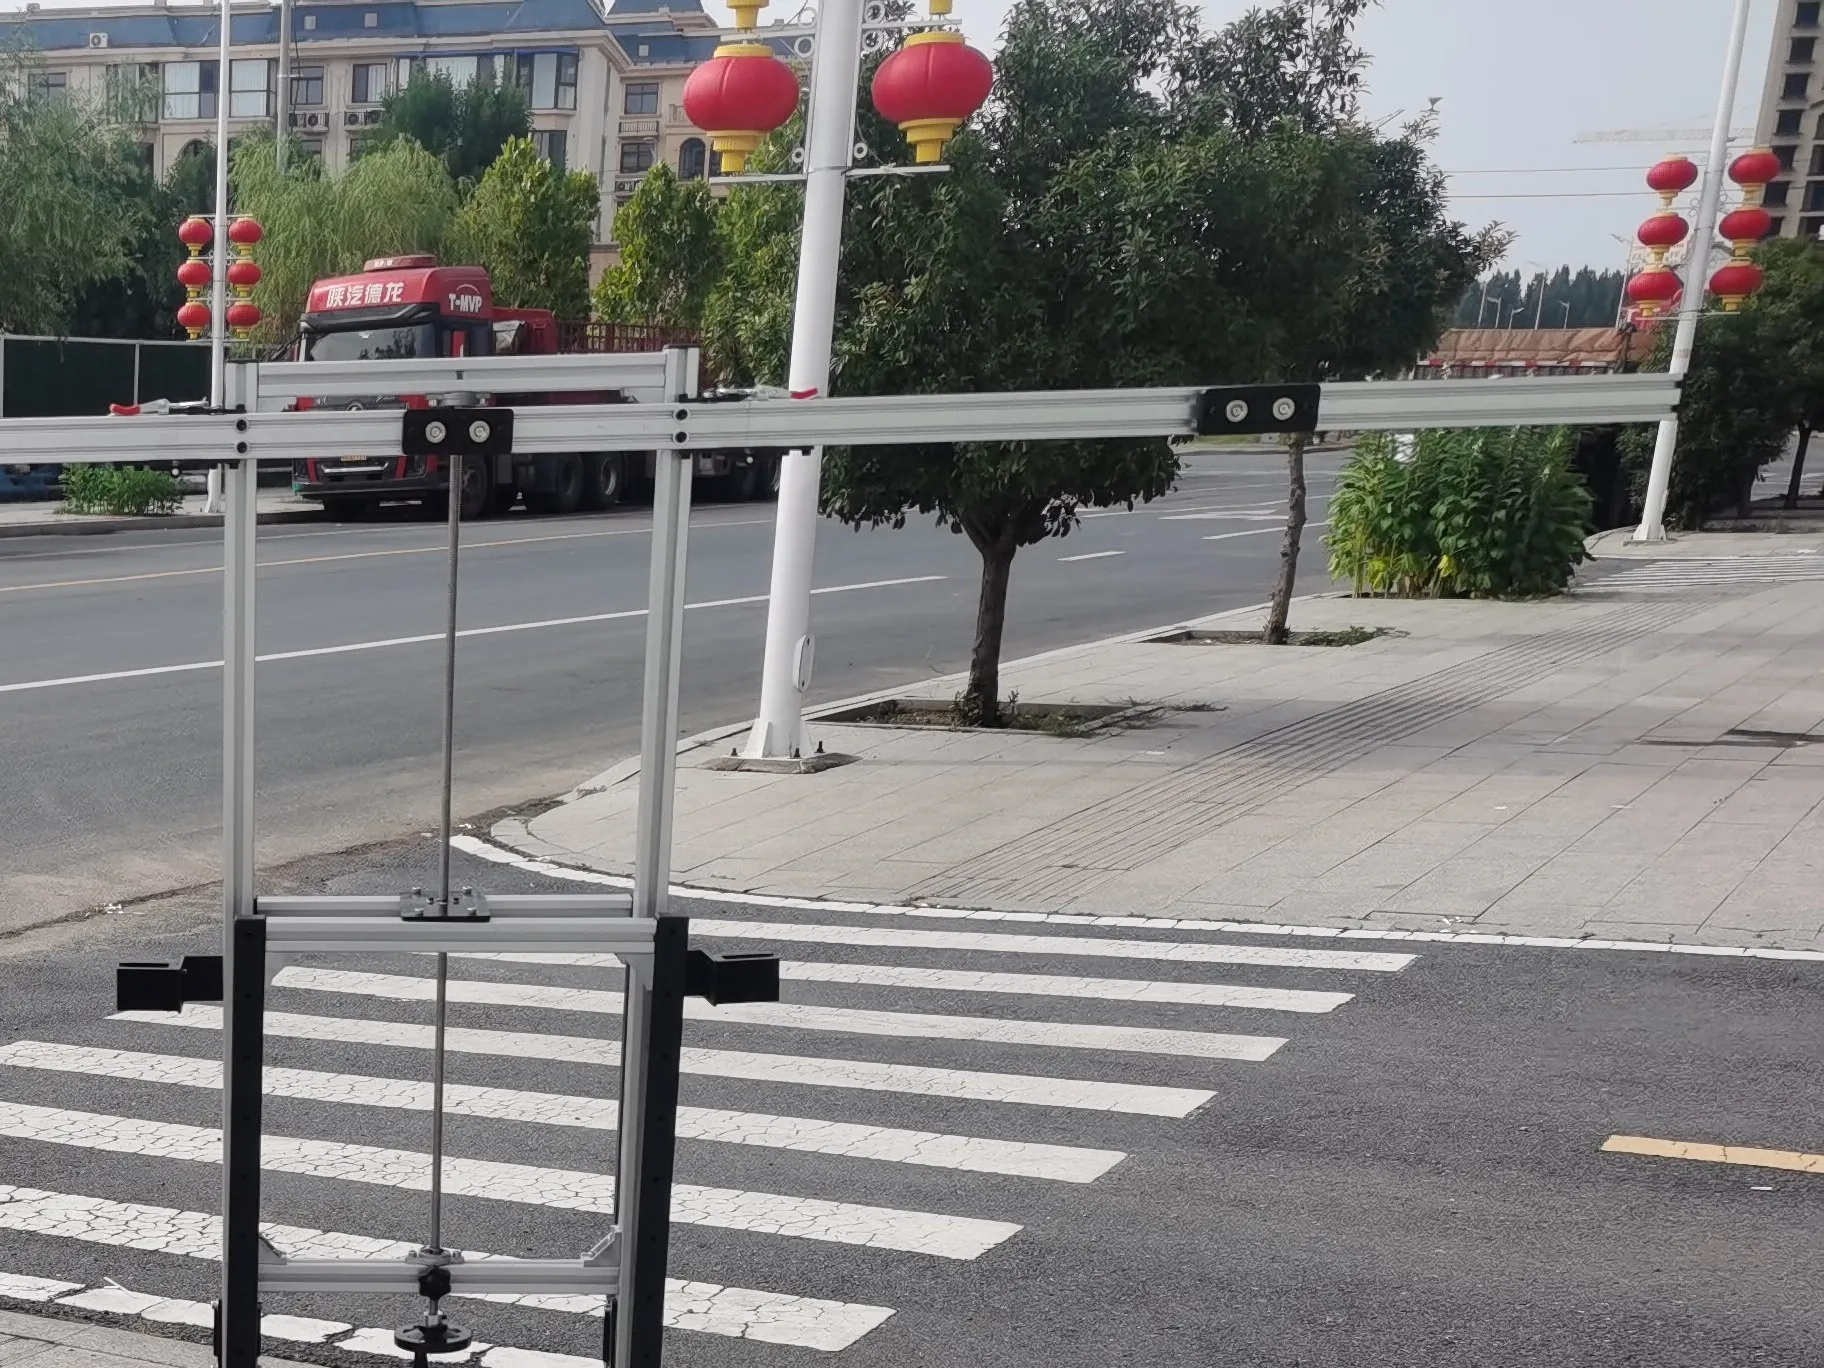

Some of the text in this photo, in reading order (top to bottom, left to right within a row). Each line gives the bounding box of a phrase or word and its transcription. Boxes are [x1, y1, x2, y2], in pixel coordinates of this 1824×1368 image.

[326, 283, 404, 308] 陕汽德龙
[448, 293, 483, 313] T-MVP
